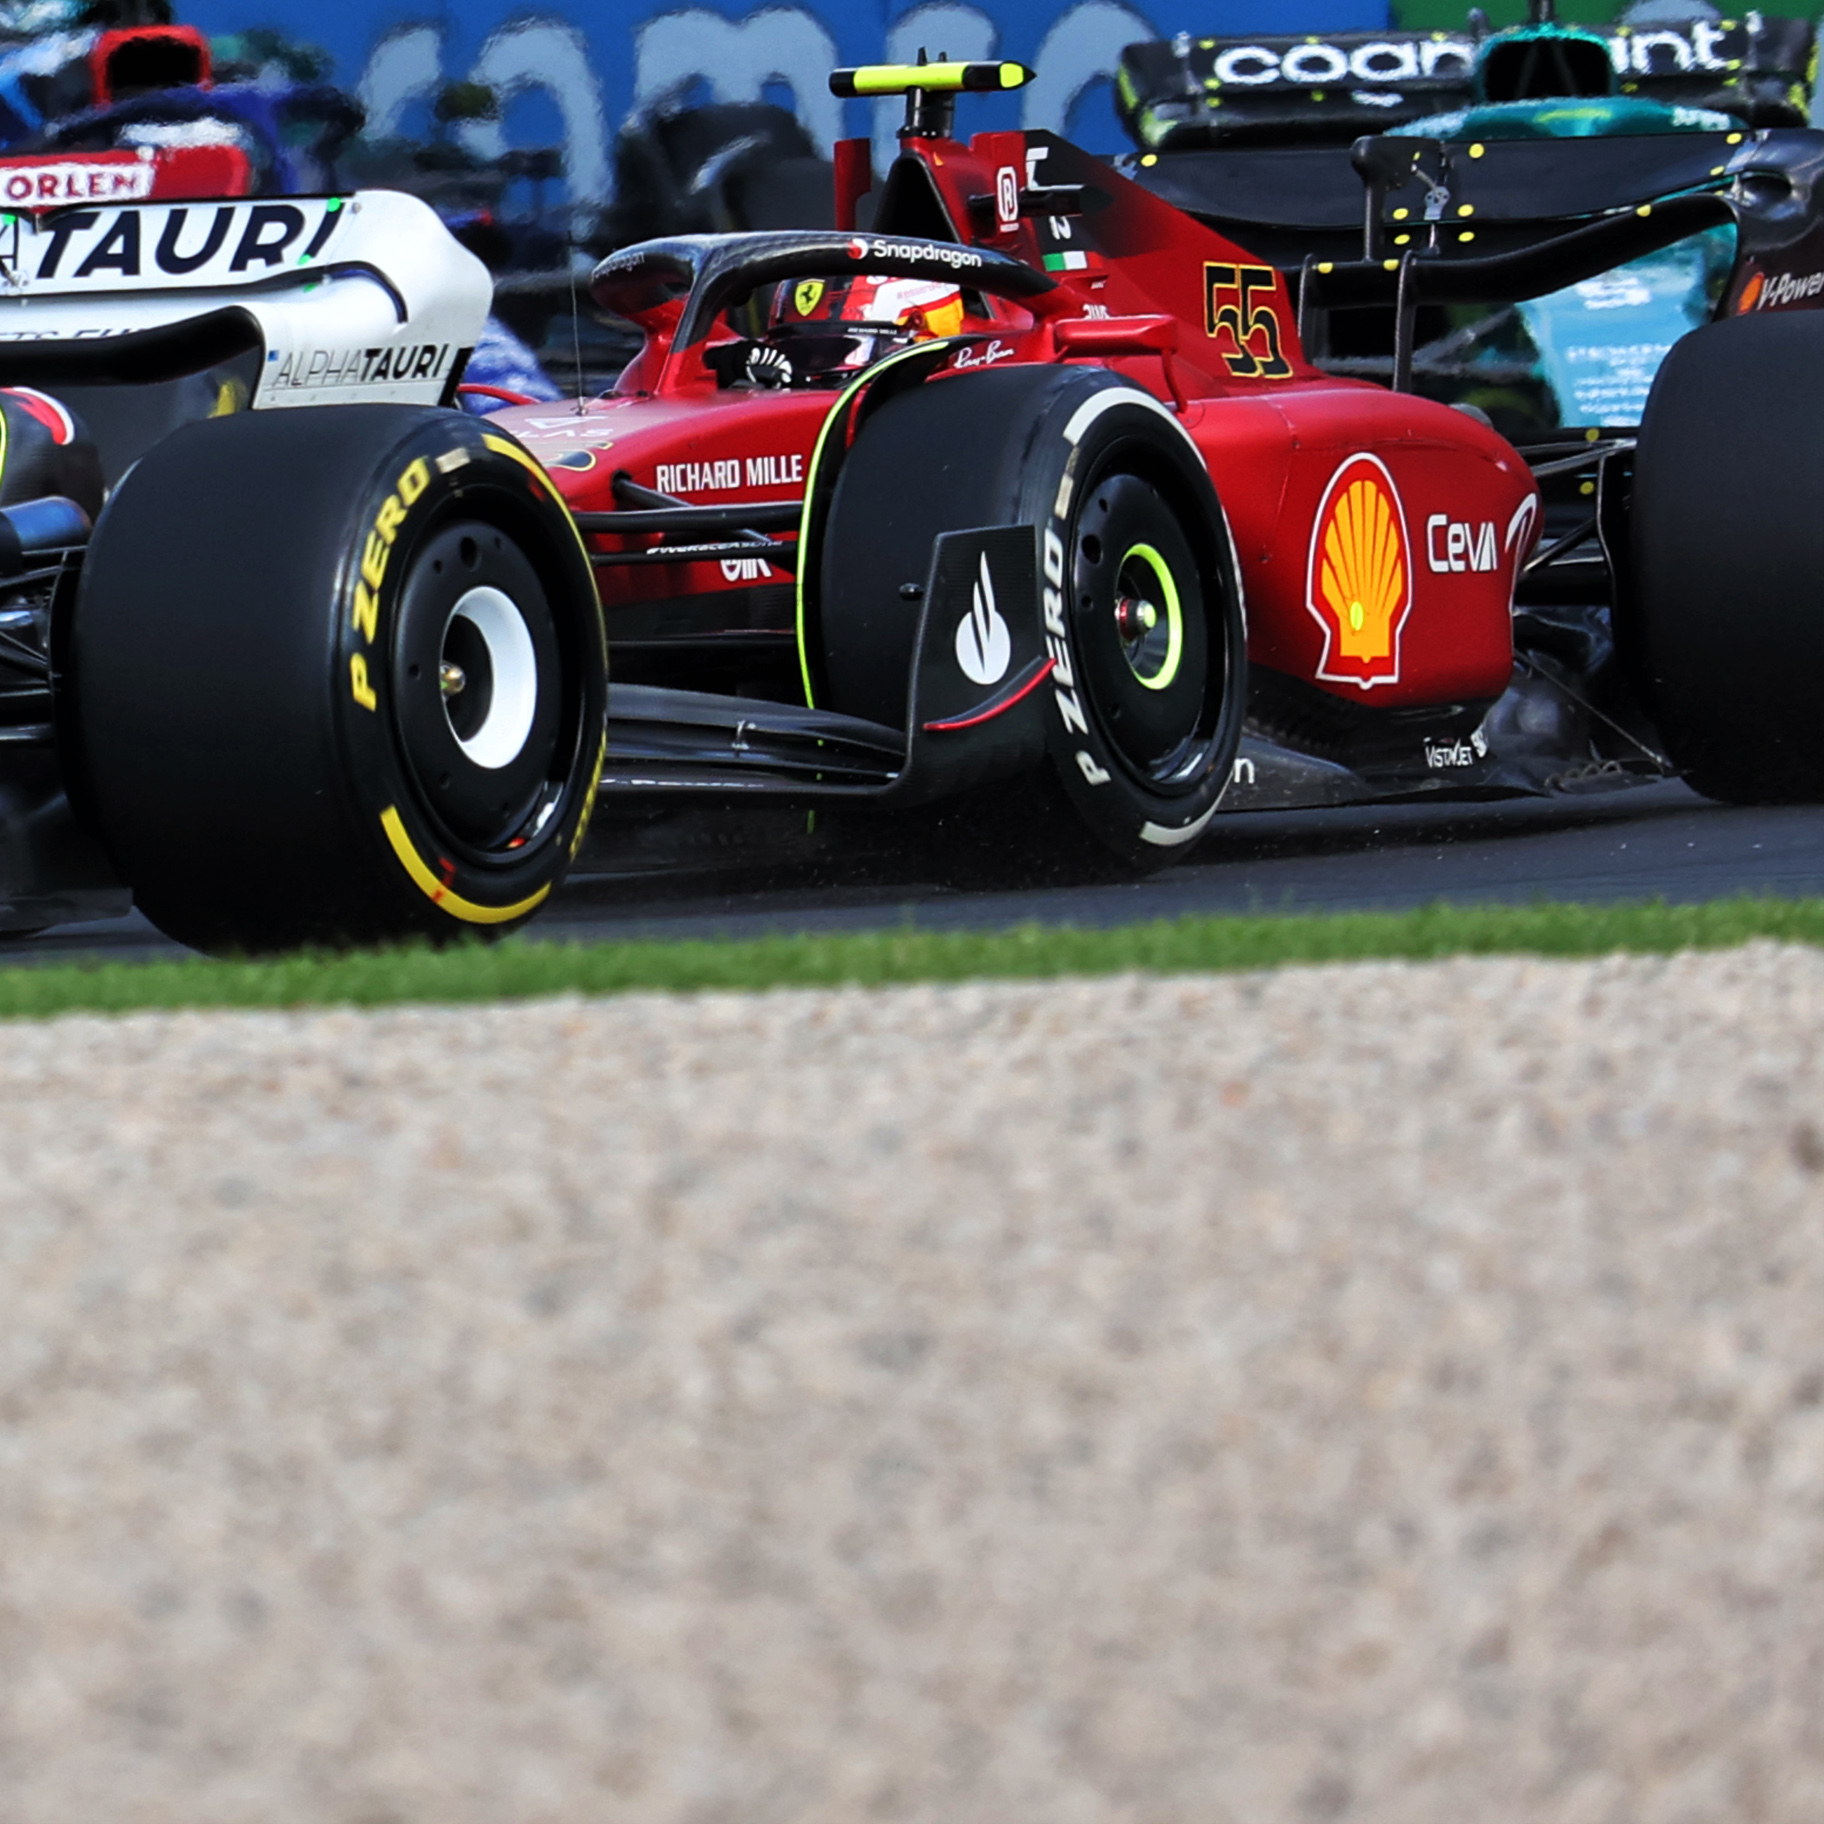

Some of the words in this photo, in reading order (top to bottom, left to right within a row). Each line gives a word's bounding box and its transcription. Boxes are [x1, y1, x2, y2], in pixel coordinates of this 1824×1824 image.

[6, 173, 139, 200] ORLEN
[873, 239, 983, 269] Snapdragon
[1203, 261, 1293, 379] 55
[272, 344, 449, 387] ALPHATAURI
[954, 340, 1014, 369] Ray-Ban
[656, 459, 741, 494] RICHARD
[745, 454, 803, 487] MILLE
[352, 454, 431, 645] ZERO
[1043, 527, 1089, 735] ZERO
[350, 652, 377, 713] P
[1075, 750, 1111, 786] P
